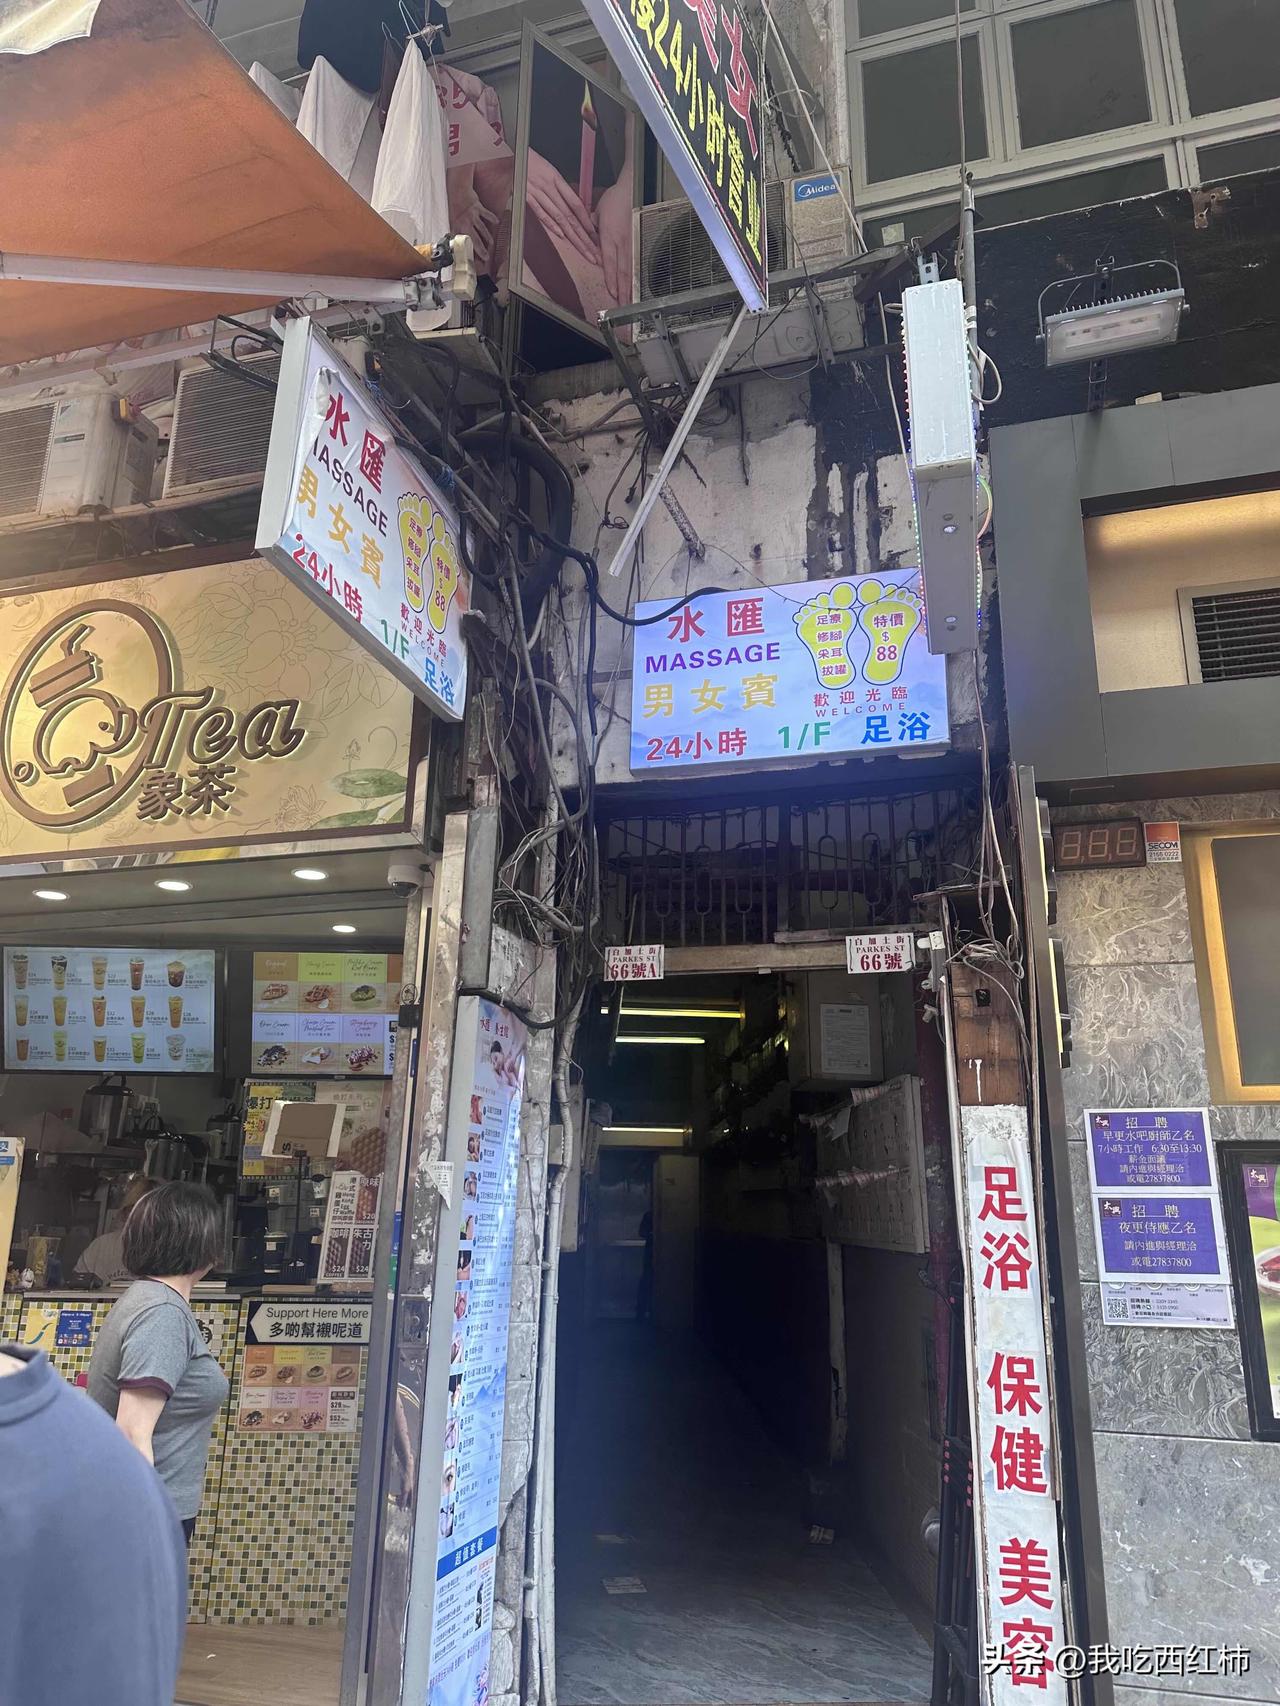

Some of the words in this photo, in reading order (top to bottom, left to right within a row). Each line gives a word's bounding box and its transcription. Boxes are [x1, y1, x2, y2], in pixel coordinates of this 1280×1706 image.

[798, 184, 836, 197] Midea
[324, 392, 386, 494] 水匯
[297, 464, 384, 588] 男女賓
[435, 590, 445, 612] 88
[291, 533, 362, 623] 24小時
[381, 619, 410, 660] 1/F
[424, 657, 455, 705] 足浴
[667, 597, 765, 643] 水匯
[873, 612, 904, 628] 特價
[400, 602, 447, 659] 歡迎光臨
[882, 631, 890, 642] $
[401, 621, 445, 667] WELCOME
[876, 645, 898, 661] 88
[645, 642, 781, 673] MASSAGE
[642, 673, 778, 719] 男女賓
[813, 686, 908, 707] 歡迎光臨
[816, 702, 906, 717] WELCOME
[138, 686, 306, 770] Tea
[647, 727, 747, 761] 24小時
[778, 722, 831, 750] 1/F
[861, 711, 931, 744] 足浴
[136, 763, 238, 821] 象茶
[1148, 841, 1178, 849] SECOM
[613, 947, 656, 956] 白加士街
[855, 936, 905, 946] 白加士街
[856, 945, 891, 953] PARKES
[611, 963, 657, 979] 66號A
[860, 953, 903, 971] 66號
[978, 1165, 1033, 1293] 足浴
[1119, 1221, 1197, 1234] 夜更侍應乙名
[266, 1307, 310, 1319] Support
[312, 1307, 338, 1318] Here
[341, 1308, 369, 1318] More
[986, 1351, 1049, 1495] 保健
[998, 1537, 1058, 1692] 美容
